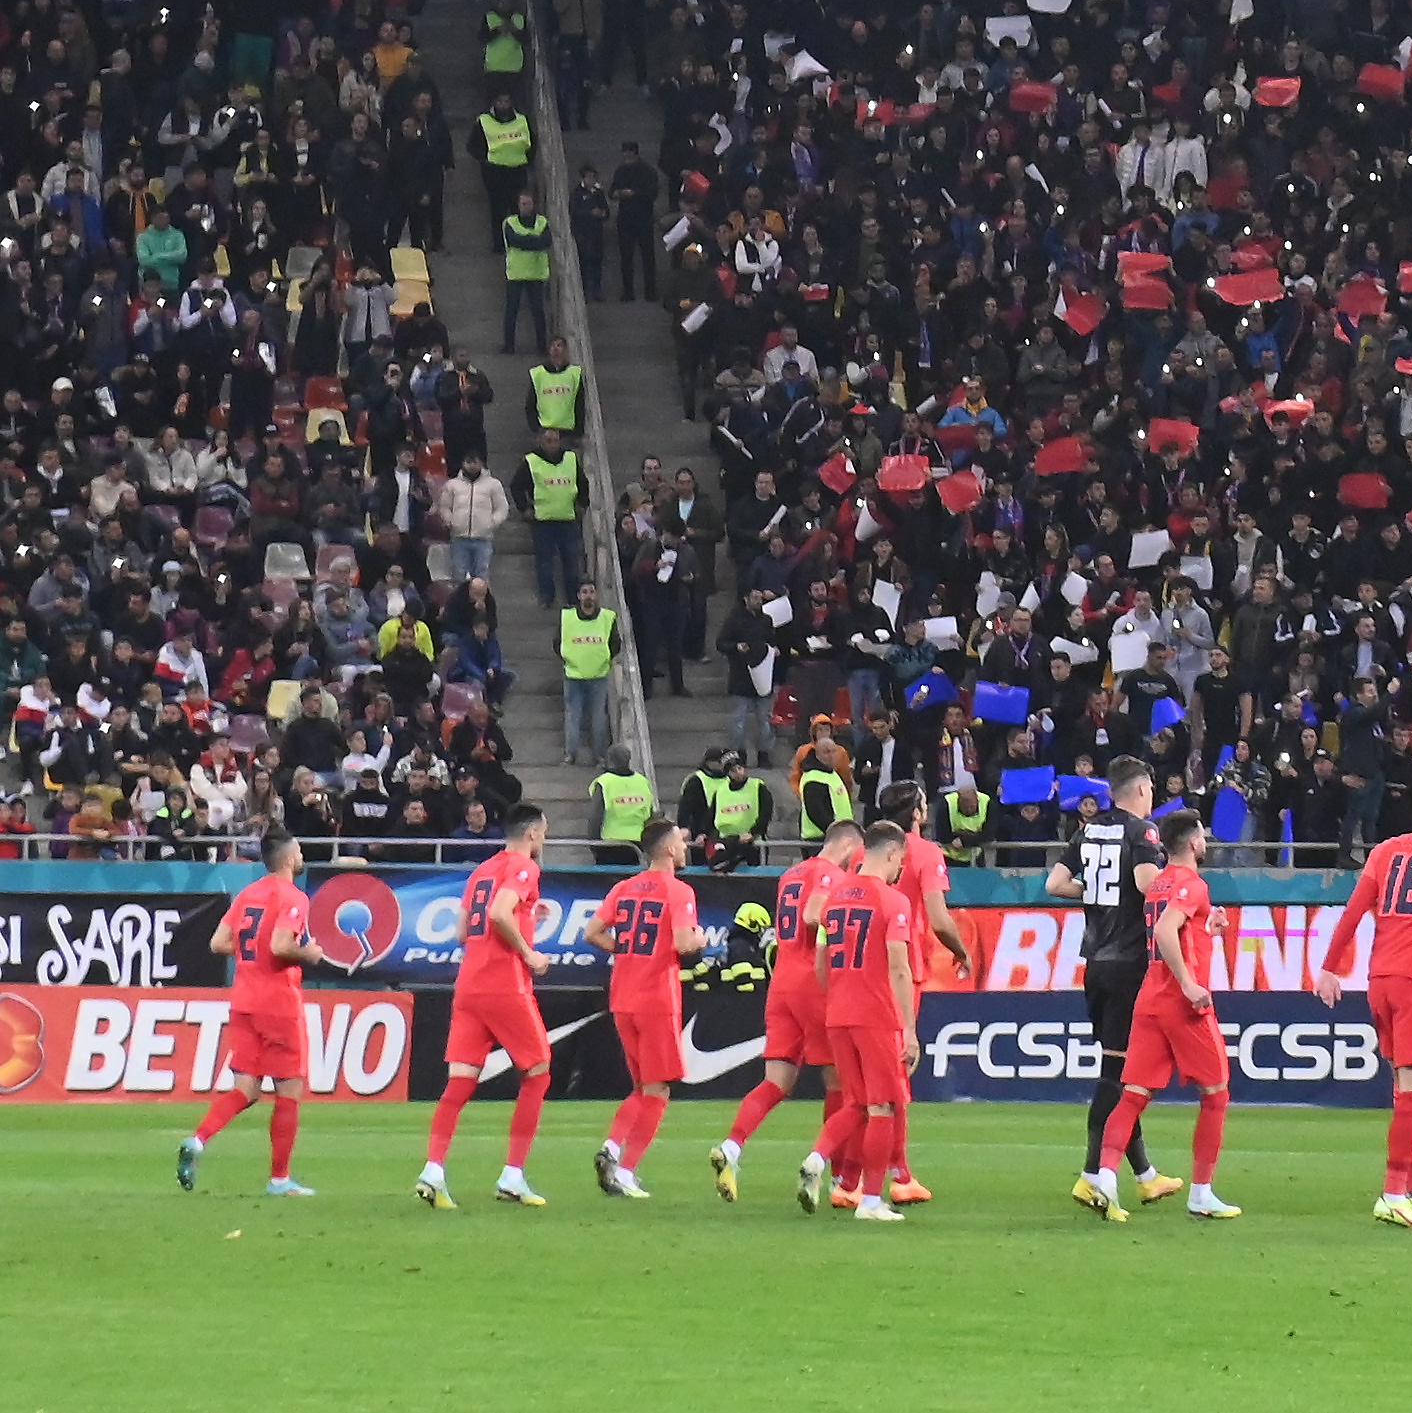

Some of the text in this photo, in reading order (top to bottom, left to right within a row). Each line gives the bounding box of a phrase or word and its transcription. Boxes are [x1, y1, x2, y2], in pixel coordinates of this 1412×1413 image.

[1081, 843, 1121, 906] 32
[238, 907, 265, 961] 2
[466, 878, 494, 937] 8
[615, 899, 664, 956] 26
[778, 883, 803, 940] 6
[826, 907, 874, 969] 27
[925, 1022, 1103, 1080] FCSB
